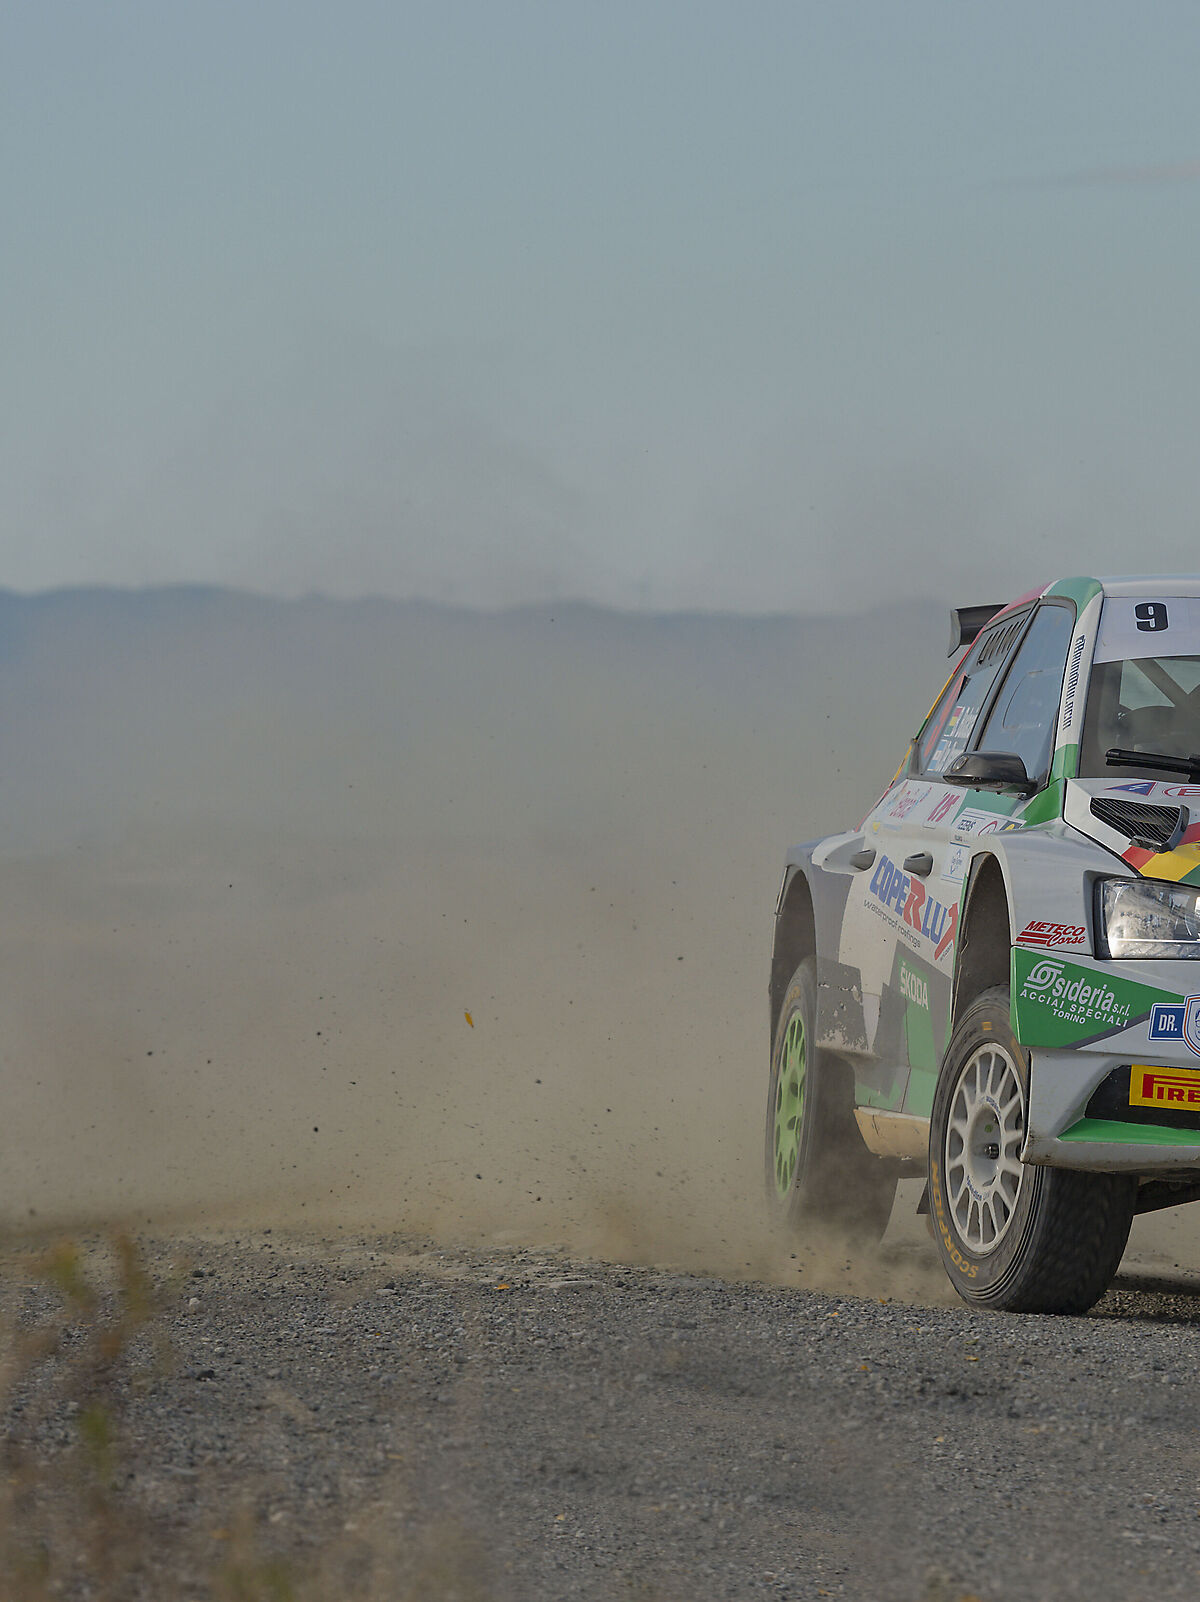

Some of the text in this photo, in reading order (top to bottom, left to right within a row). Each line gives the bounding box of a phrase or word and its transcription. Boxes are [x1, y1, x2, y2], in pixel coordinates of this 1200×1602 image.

[1134, 602, 1169, 633] 9
[1024, 920, 1086, 937] METECO
[1046, 931, 1086, 947] Corse
[1052, 977, 1115, 1012] sideria
[1020, 989, 1129, 1028] ACCIAI SPECIALI
[1053, 1008, 1086, 1025] TORINO
[1158, 1013, 1178, 1032] DR.
[932, 1160, 979, 1278] SCORPION
